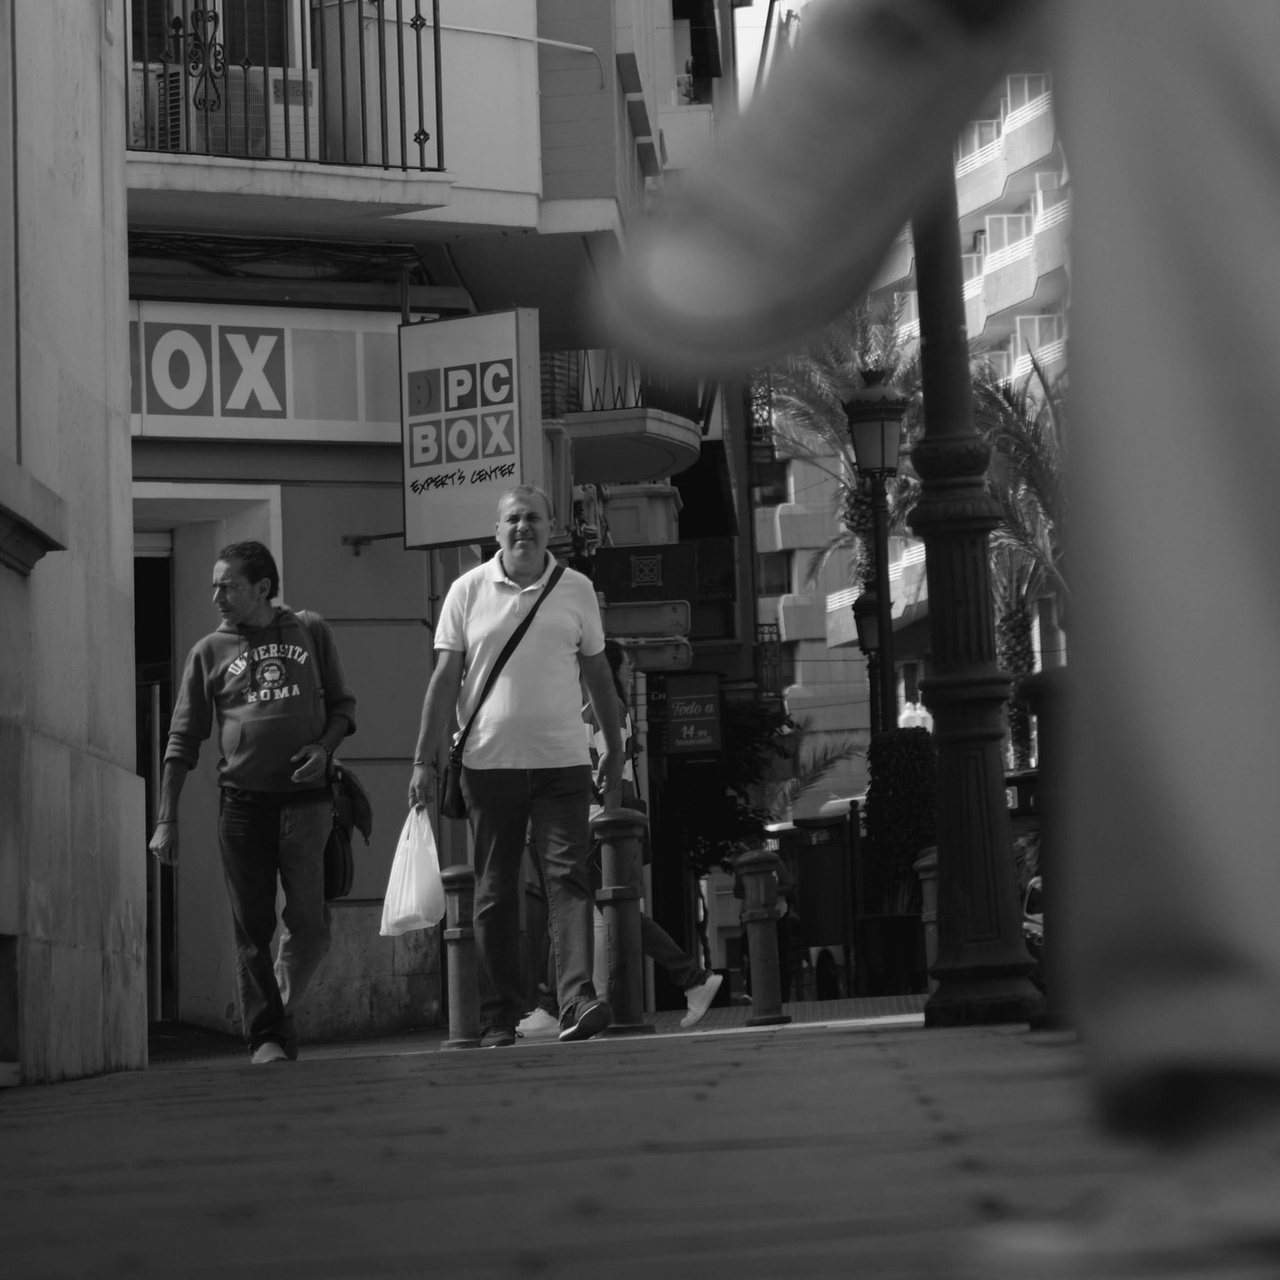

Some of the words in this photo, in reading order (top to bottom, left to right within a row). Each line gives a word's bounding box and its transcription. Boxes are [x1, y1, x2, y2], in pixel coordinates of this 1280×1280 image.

[131, 329, 283, 411] OX
[448, 362, 511, 408] PC
[412, 413, 513, 465] BOX
[409, 468, 466, 495] EXPERT'S
[470, 462, 516, 484] CENTER
[248, 684, 300, 702] ROMA
[671, 700, 702, 717] Todo
